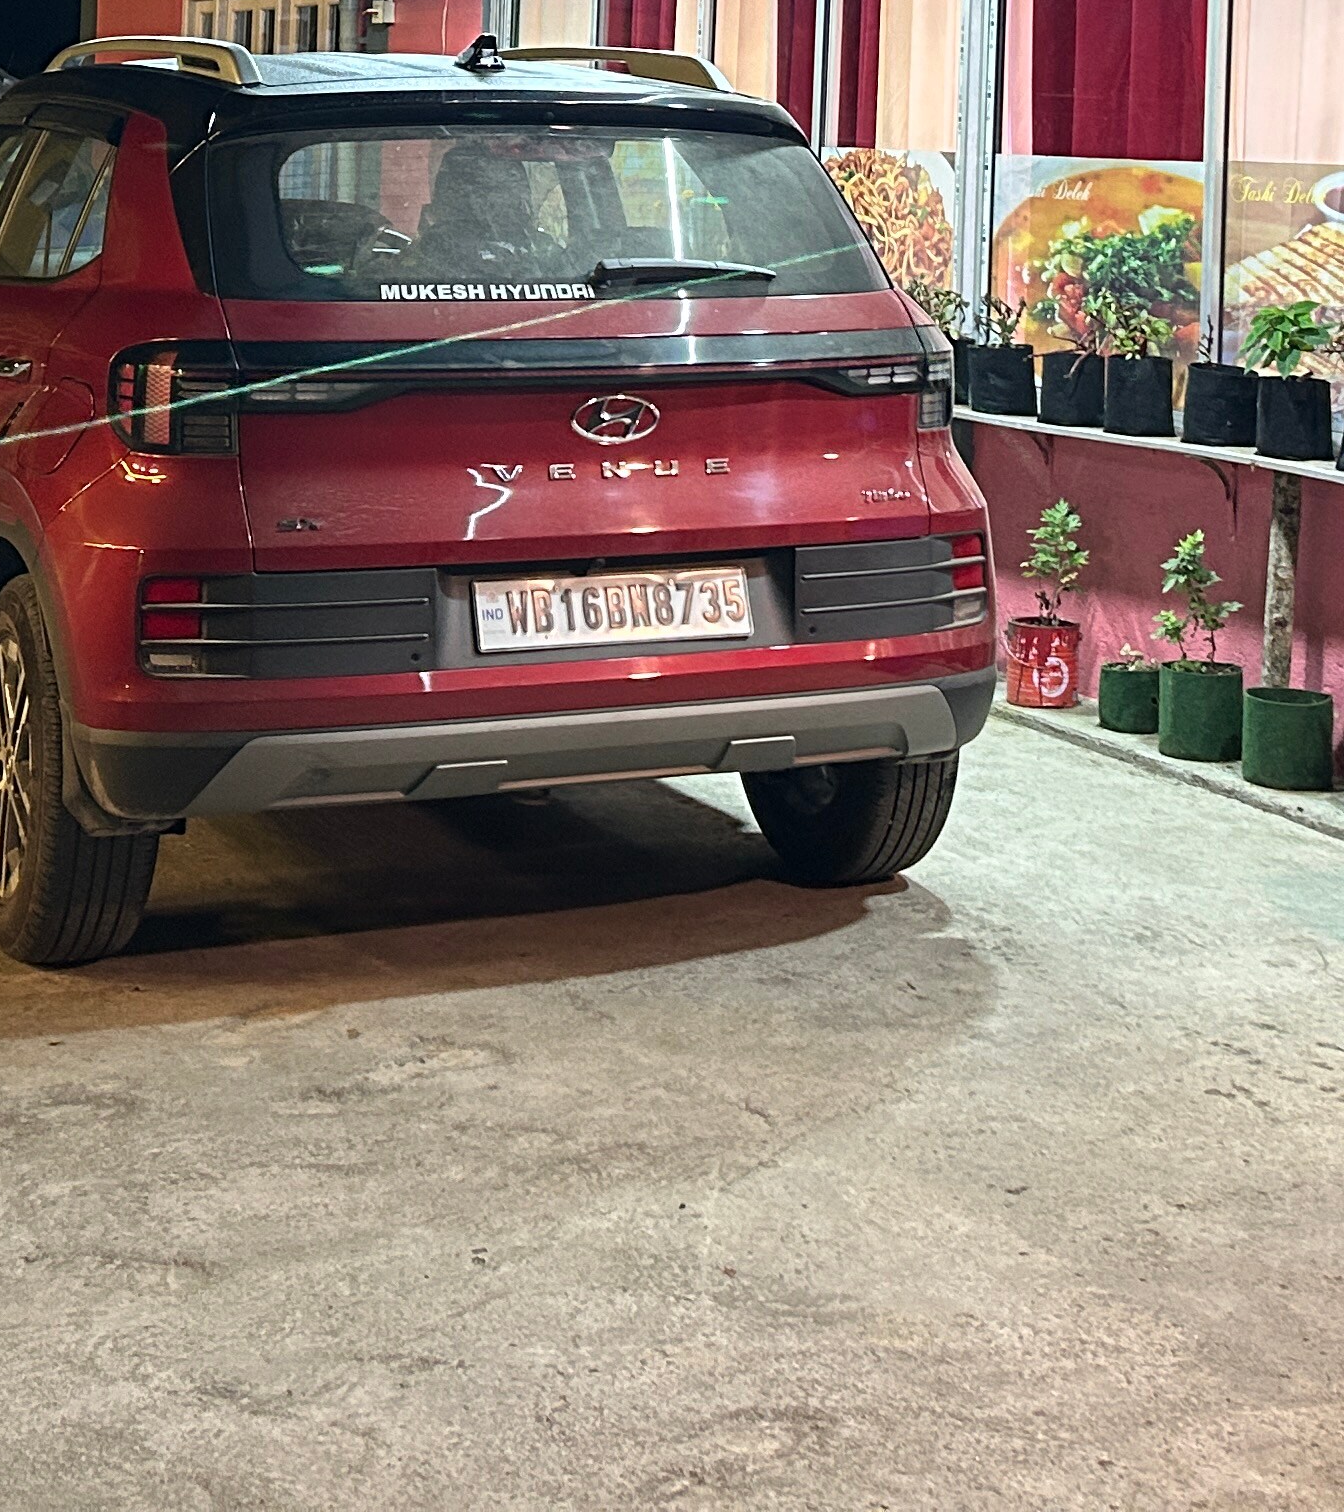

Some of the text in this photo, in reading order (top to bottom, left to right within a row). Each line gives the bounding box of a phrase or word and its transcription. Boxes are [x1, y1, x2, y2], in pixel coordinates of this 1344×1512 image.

[1053, 180, 1093, 201] Delek
[1229, 175, 1277, 204] Tashi
[380, 283, 595, 300] MUKESH HYUNDAI
[490, 457, 732, 481] VENUE
[482, 607, 504, 621] IND
